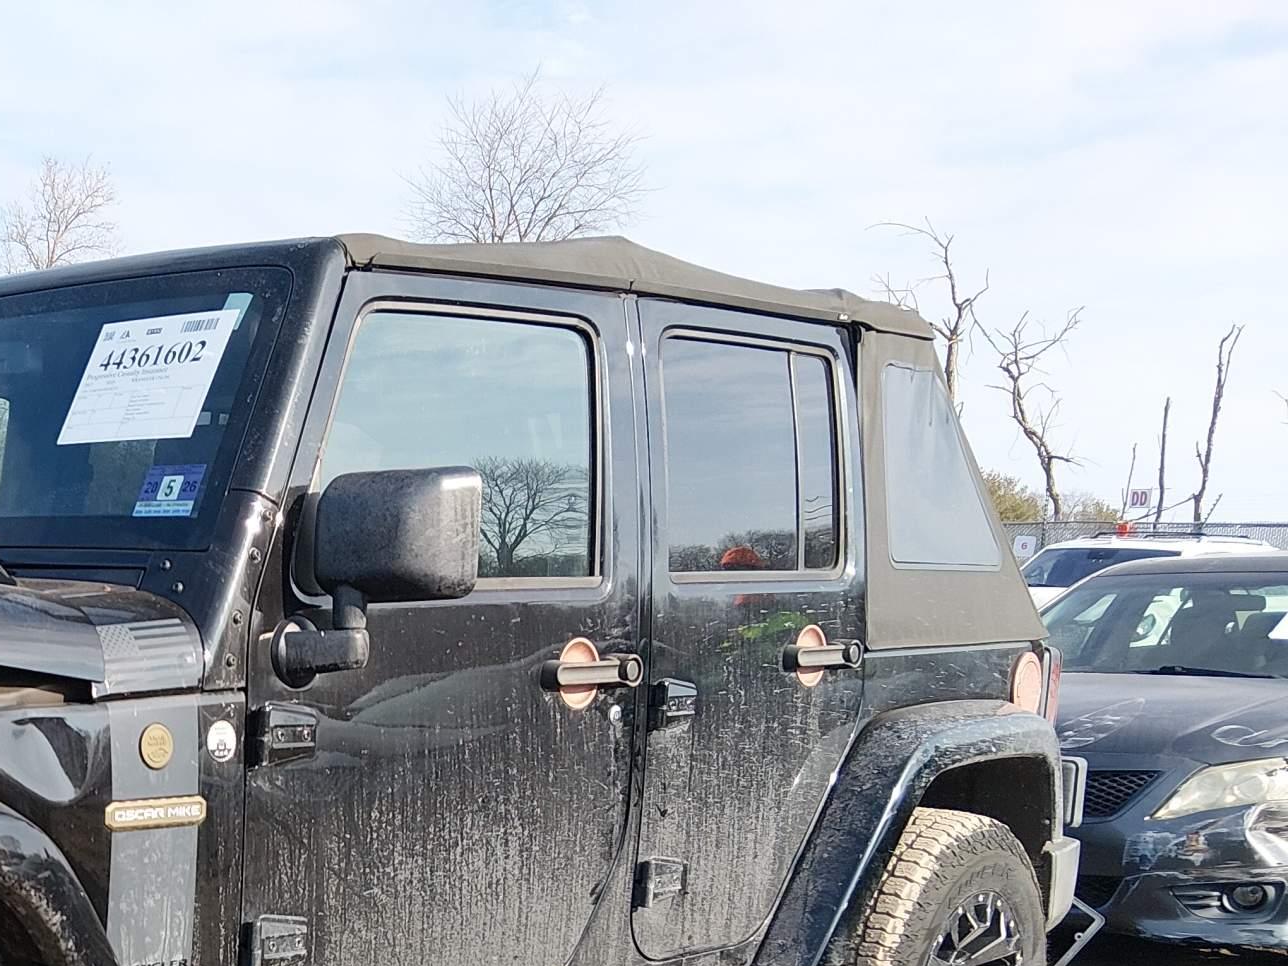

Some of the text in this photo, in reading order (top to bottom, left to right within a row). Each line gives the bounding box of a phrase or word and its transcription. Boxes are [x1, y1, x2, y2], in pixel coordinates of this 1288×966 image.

[99, 340, 207, 371] 44361602
[144, 479, 198, 497] 20 5 26
[1131, 491, 1148, 507] DD
[167, 804, 201, 818] MIKE
